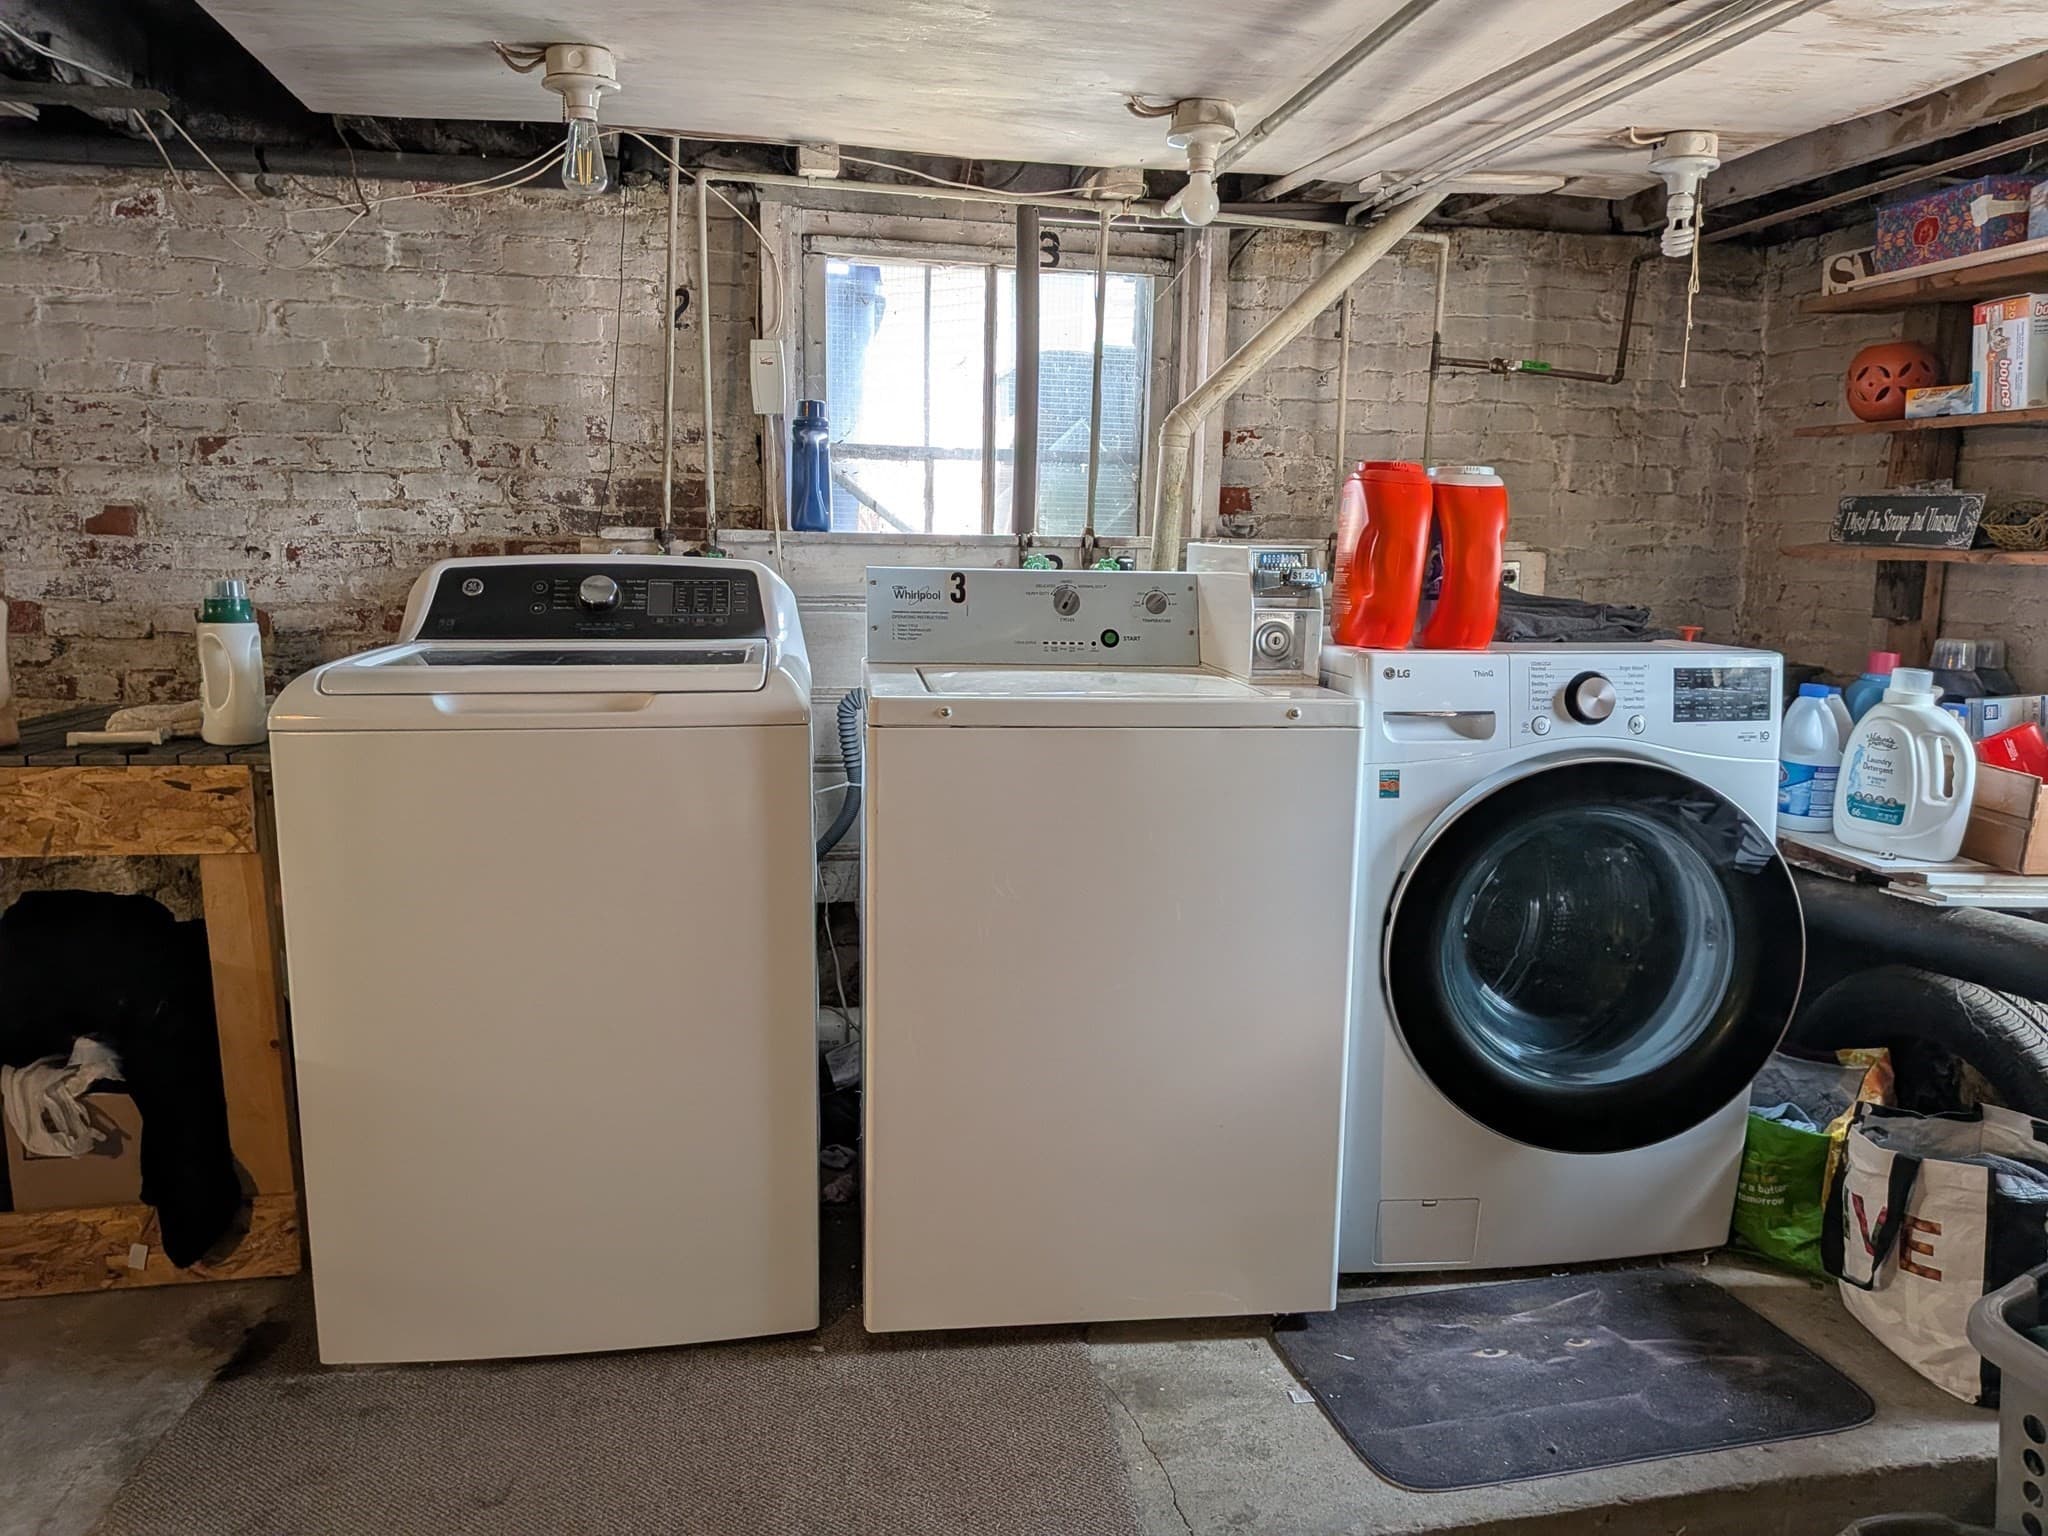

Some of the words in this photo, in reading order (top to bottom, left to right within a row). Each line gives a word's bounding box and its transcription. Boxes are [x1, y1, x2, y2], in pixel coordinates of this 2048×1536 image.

[1040, 231, 1060, 268] 3
[674, 287, 690, 331] 2
[1999, 359, 2012, 408] bounce
[1850, 509, 1873, 536] Myself
[1880, 508, 1910, 542] Strange
[1908, 505, 1930, 532] And
[1926, 504, 1965, 533] Unusual
[1292, 571, 1315, 581] $1.50
[950, 572, 967, 604] 3
[893, 590, 941, 603] Whirlpool
[1396, 669, 1411, 679] LG
[1473, 670, 1494, 678] ThinQ
[1862, 761, 1894, 775] Detergent
[1866, 754, 1893, 768] Laundry
[1851, 806, 1862, 817] 66
[1748, 1184, 1755, 1193] a
[1737, 1191, 1785, 1206] tomorrow
